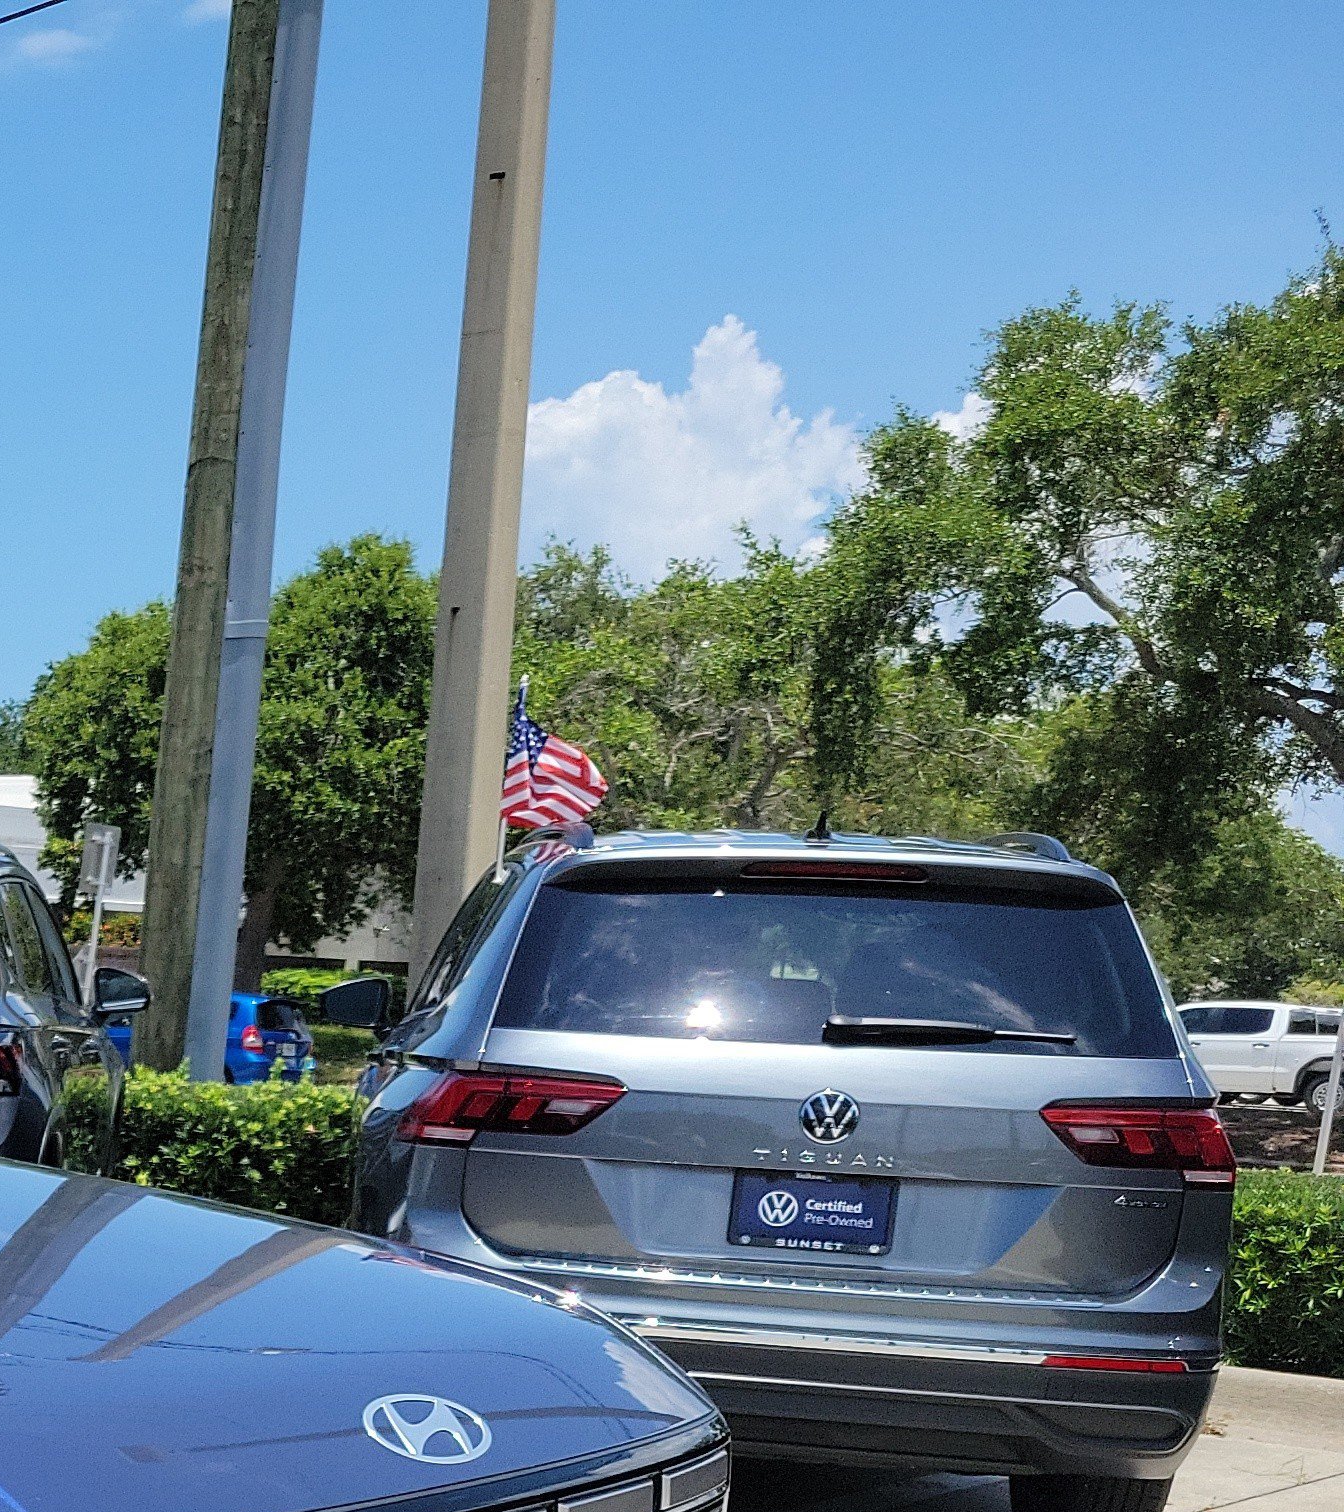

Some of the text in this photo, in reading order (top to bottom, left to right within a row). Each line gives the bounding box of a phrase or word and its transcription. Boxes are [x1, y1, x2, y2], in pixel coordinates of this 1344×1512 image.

[753, 1147, 895, 1169] TIGUAN
[806, 1199, 863, 1214] Certified
[804, 1213, 874, 1229] Pre-Owned
[775, 1238, 844, 1251] SUNSET
